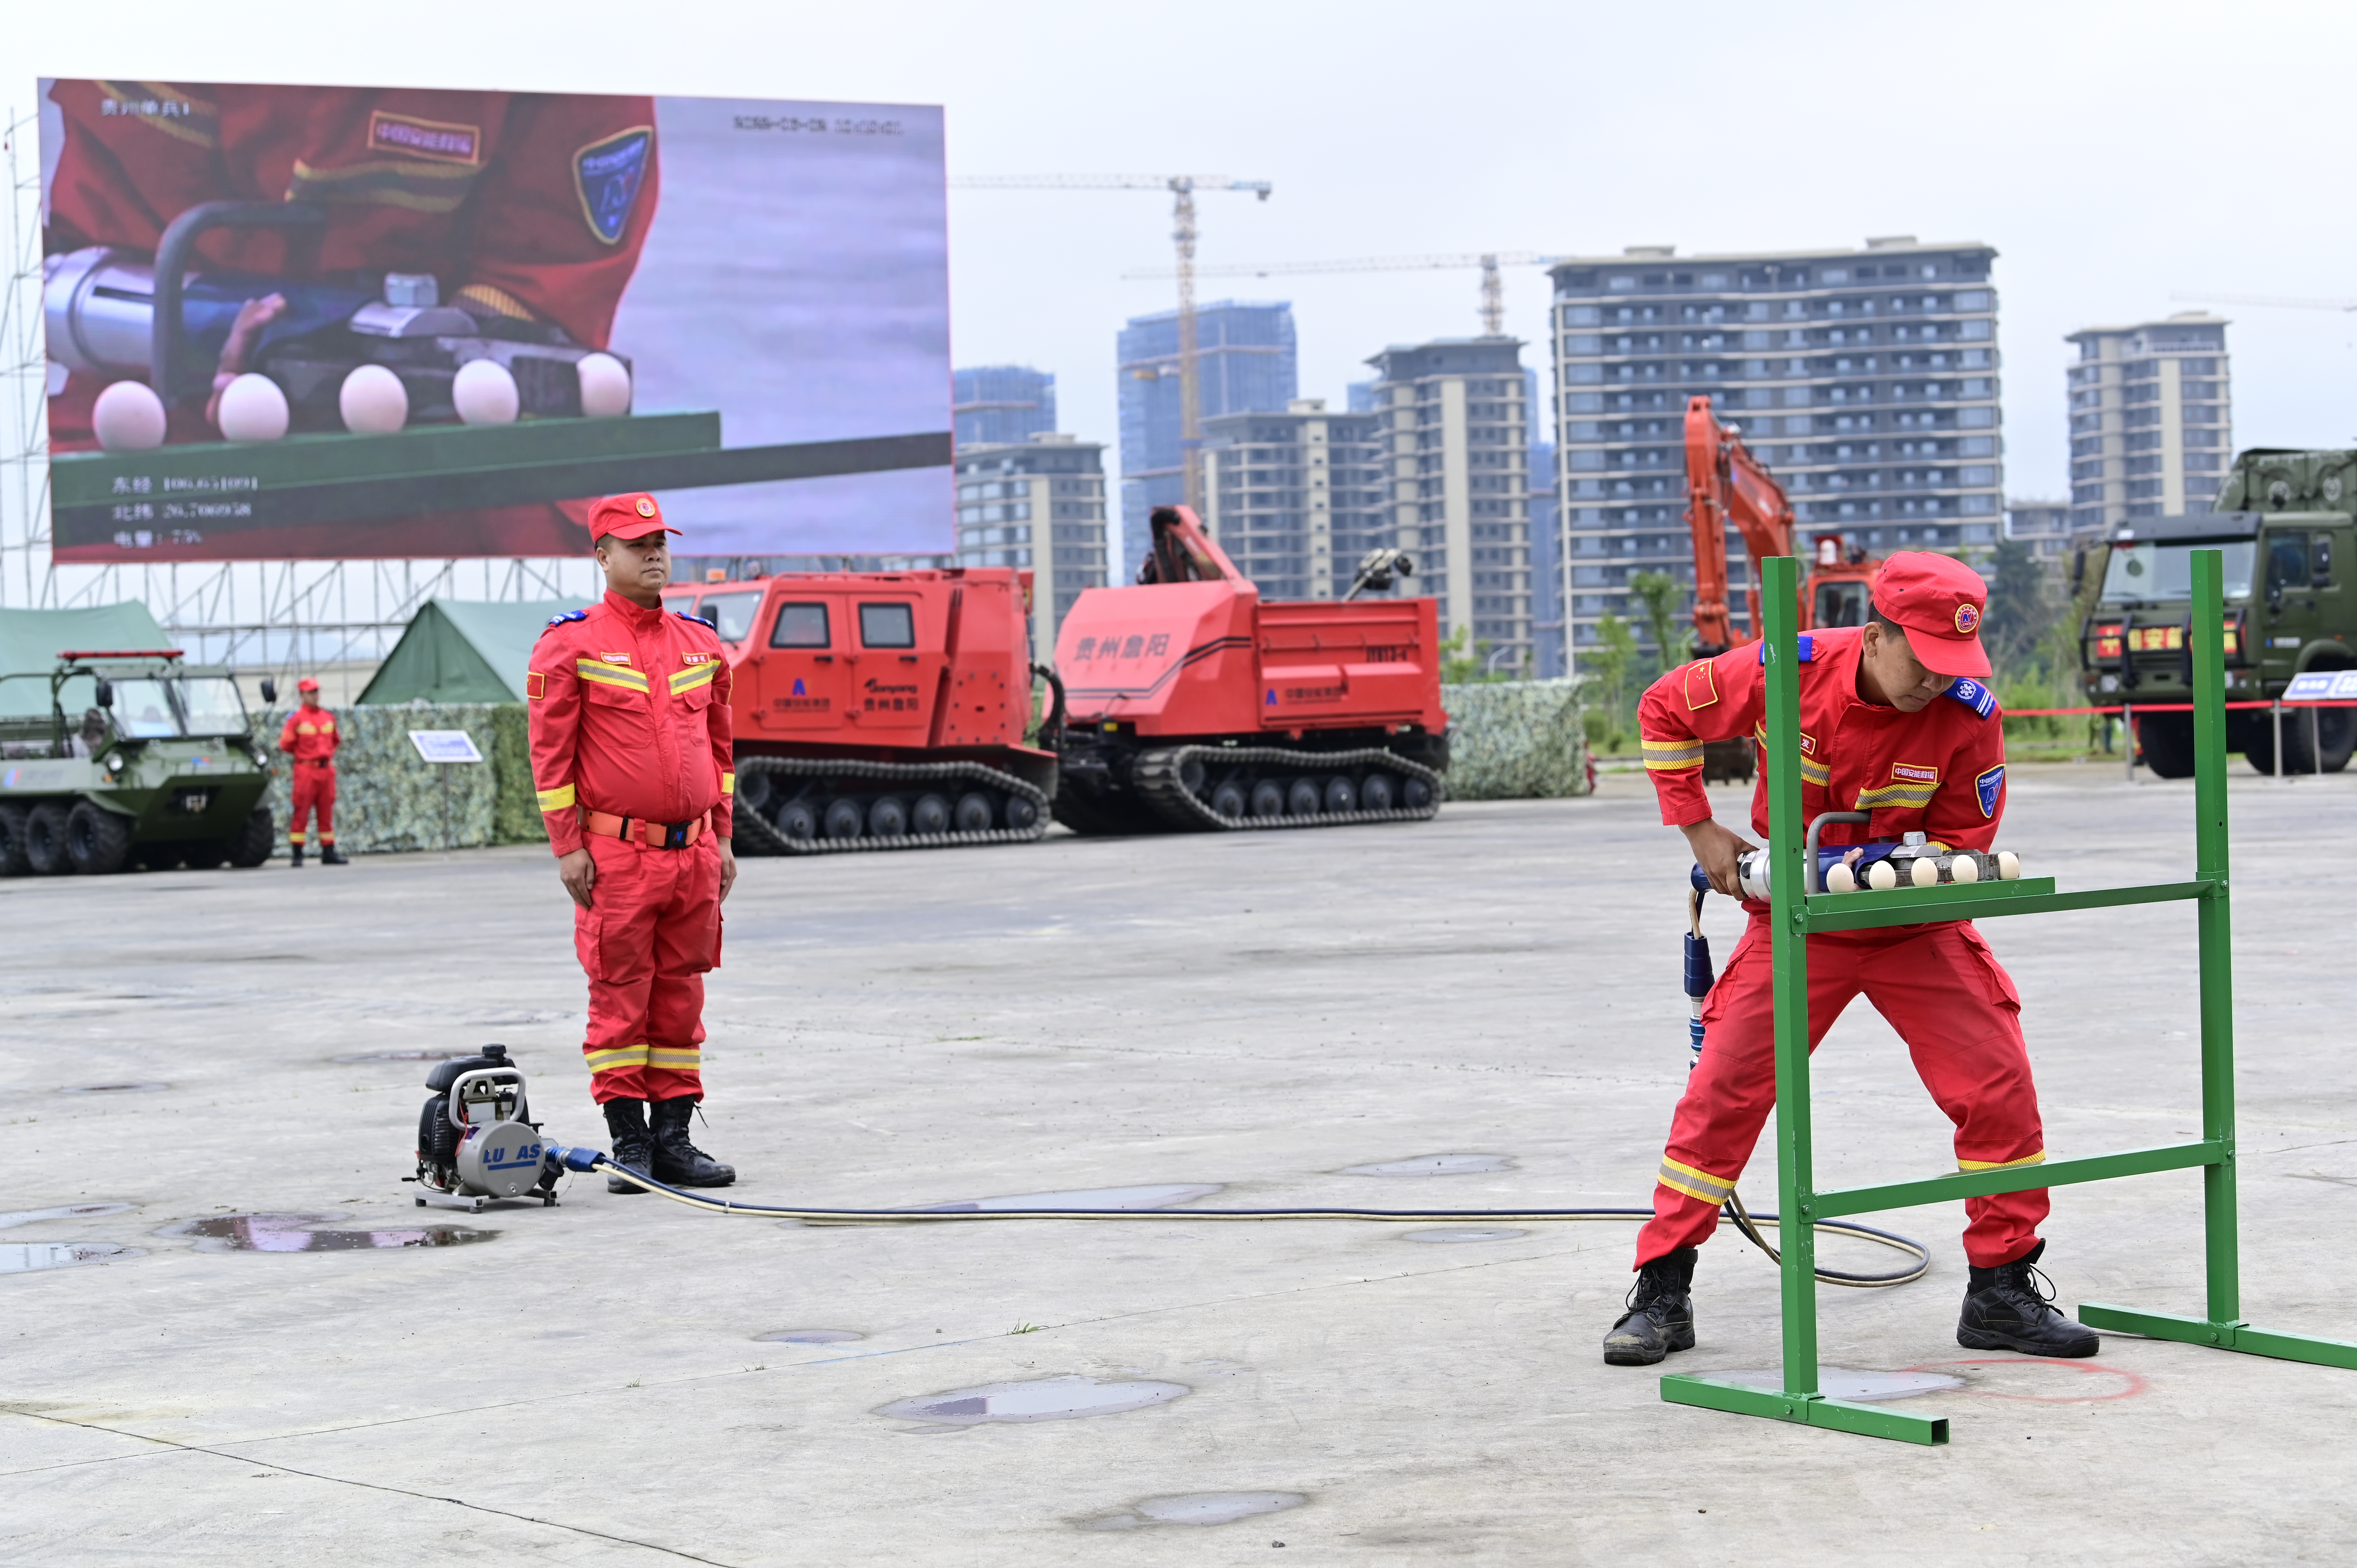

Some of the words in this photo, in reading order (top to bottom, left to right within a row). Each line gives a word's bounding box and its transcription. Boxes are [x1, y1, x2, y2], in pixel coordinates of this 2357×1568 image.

[112, 476, 152, 494] 东经
[112, 503, 154, 521] 北纬
[1895, 767, 1935, 779] 中国安能救援
